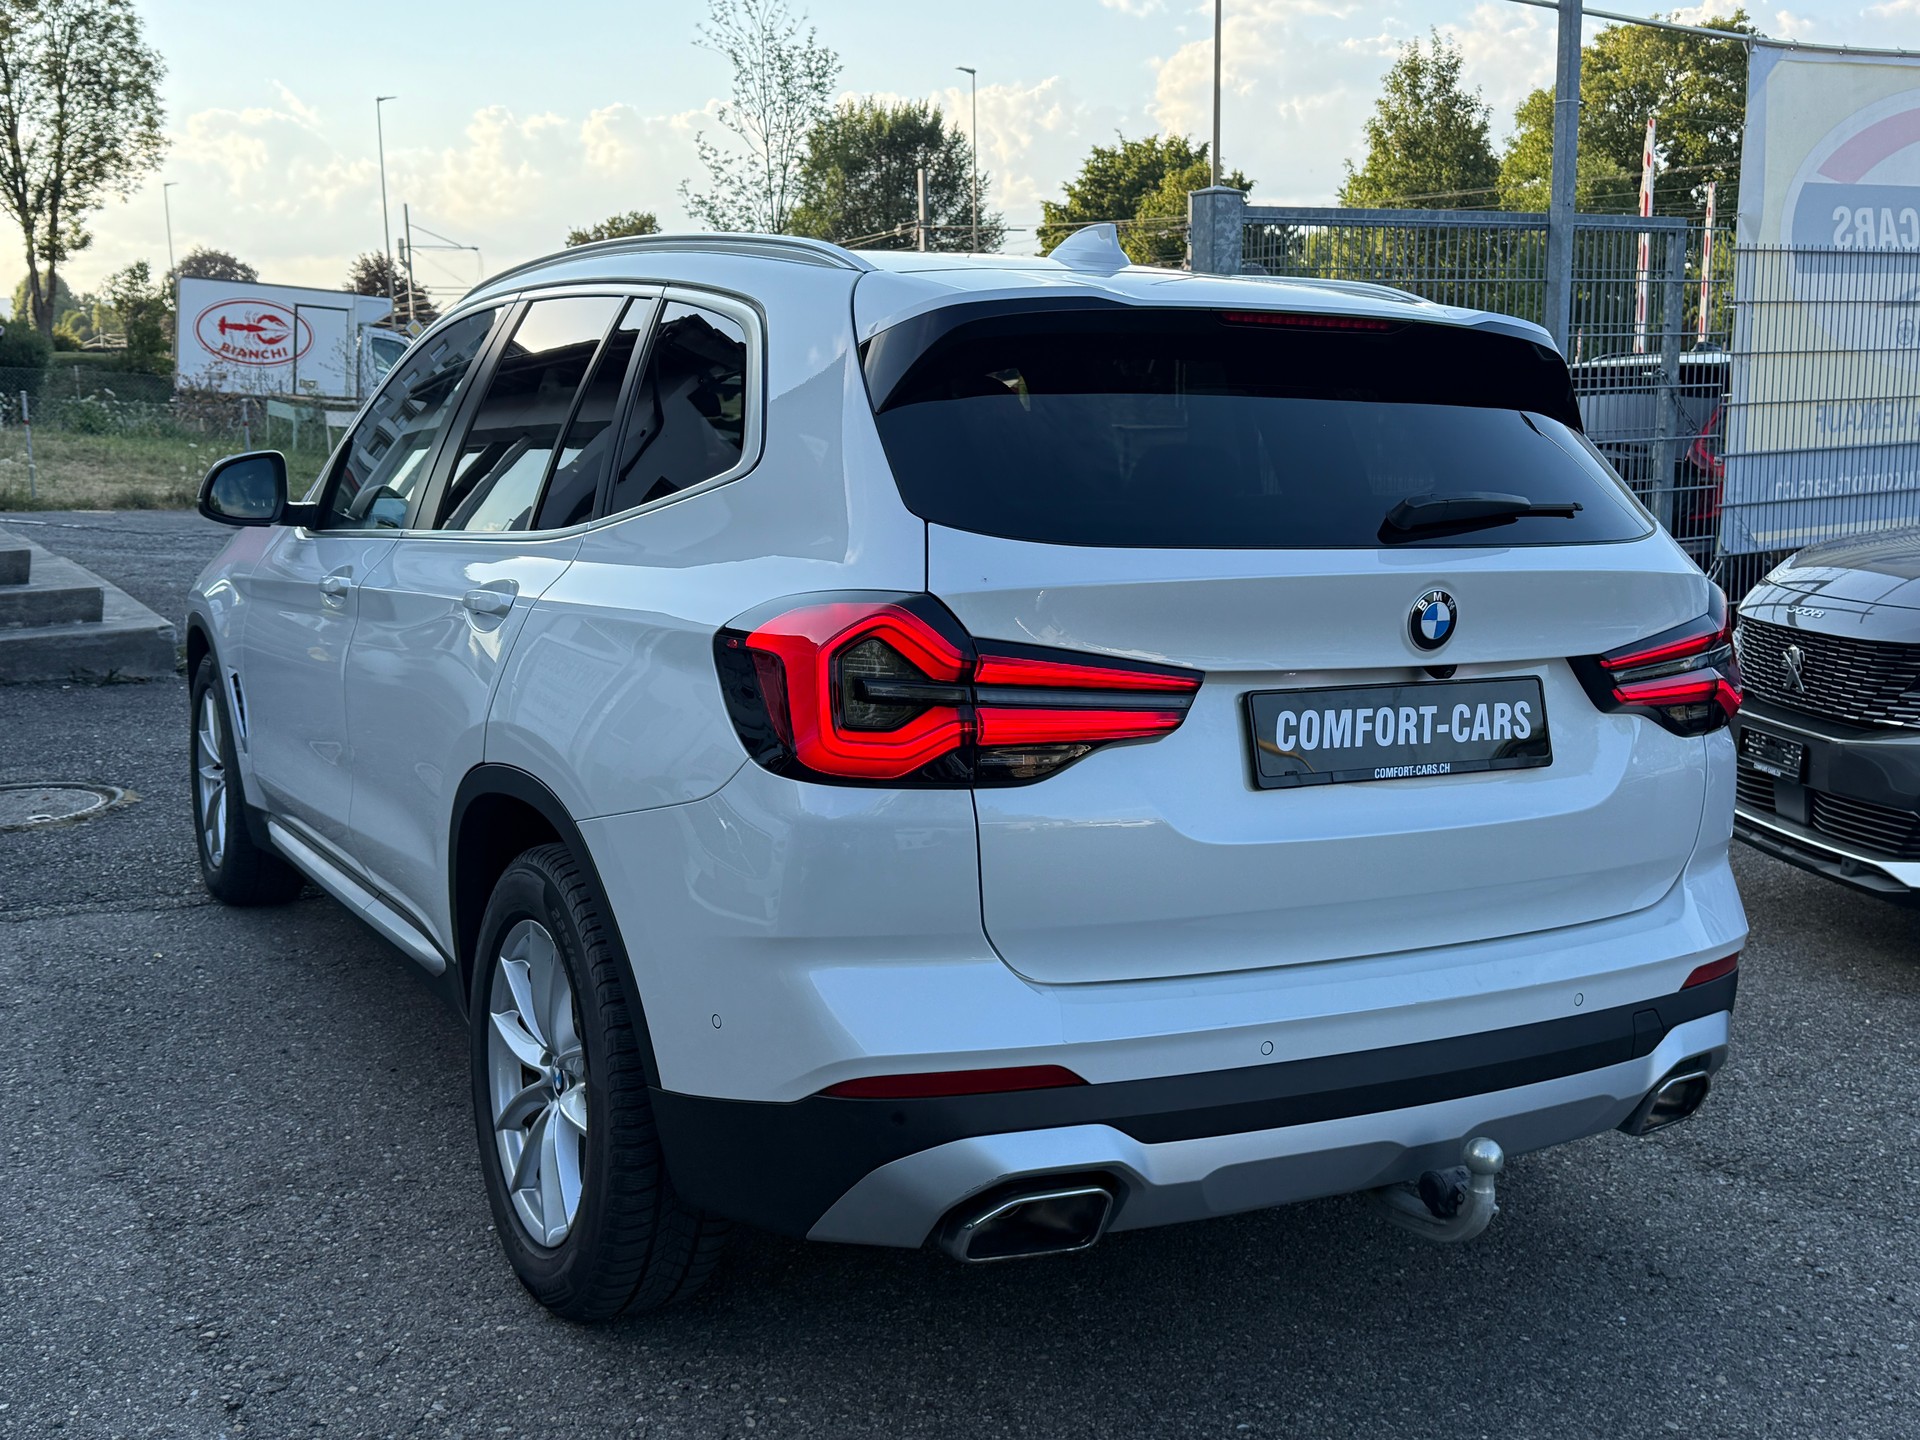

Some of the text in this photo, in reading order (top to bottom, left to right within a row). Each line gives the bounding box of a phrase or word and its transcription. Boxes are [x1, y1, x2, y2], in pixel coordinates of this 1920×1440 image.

[220, 342, 288, 359] BIANCHI
[1417, 591, 1456, 611] BMW
[1275, 700, 1532, 752] COMFORT-CARS
[1374, 762, 1451, 779] COMFORT-CARS.CH
